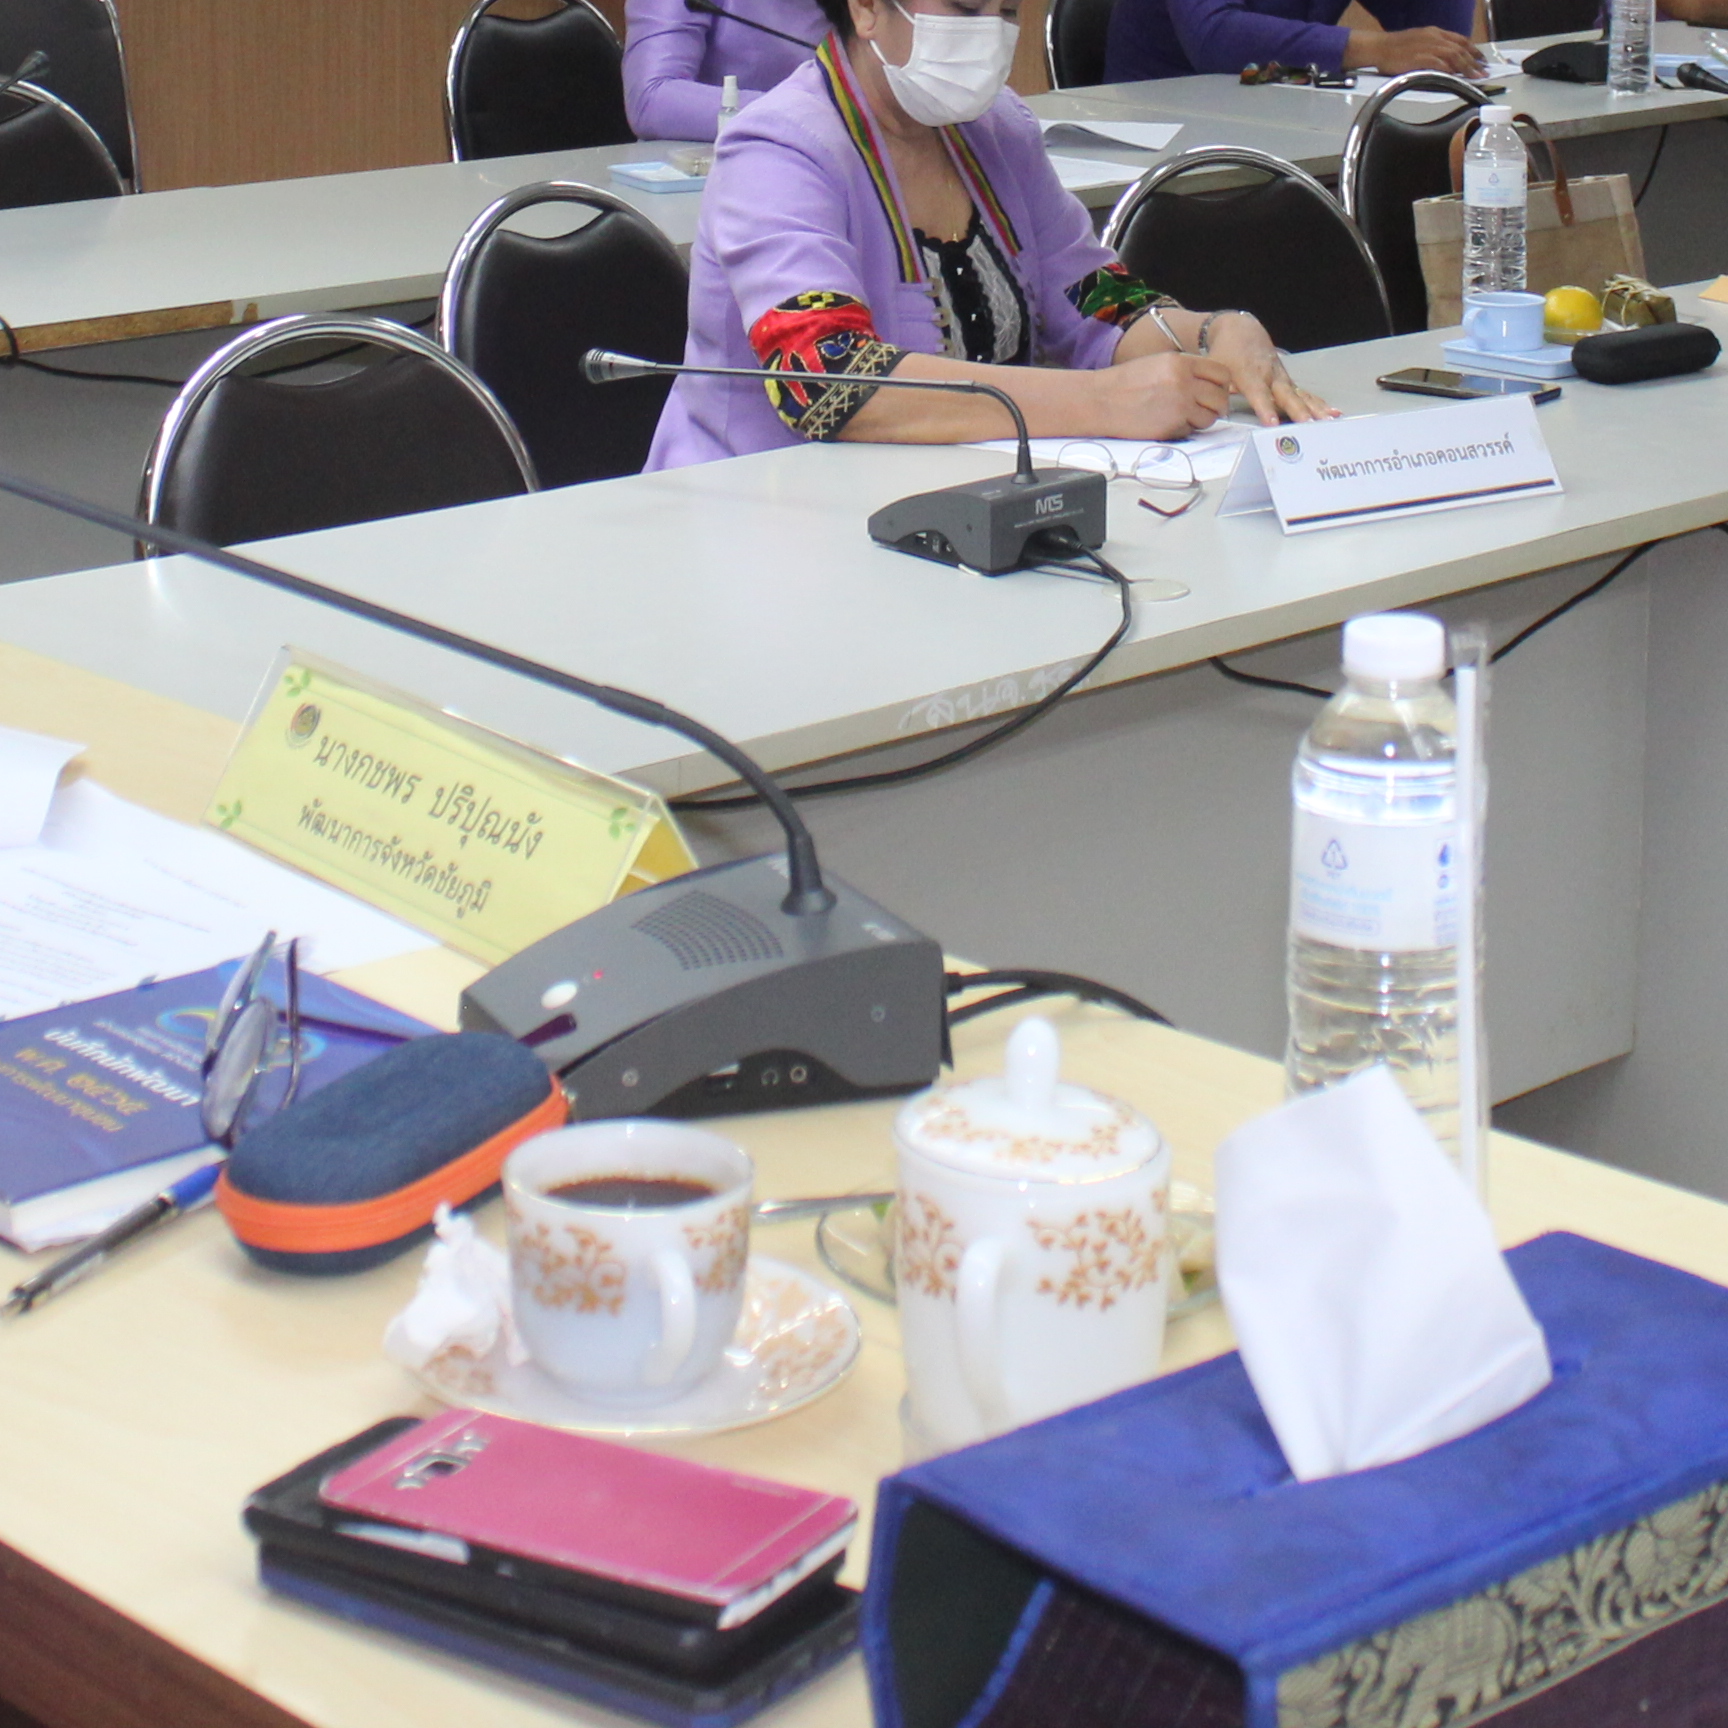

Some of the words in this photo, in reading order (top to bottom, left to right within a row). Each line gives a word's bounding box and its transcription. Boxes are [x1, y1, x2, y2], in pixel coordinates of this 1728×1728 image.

[1316, 432, 1516, 483] พัฒนาการอำเภอคอนสวรรค์
[314, 735, 423, 804] นางกชพร
[299, 800, 492, 918] พัฒนาการจังหวัดชัยภูมิ
